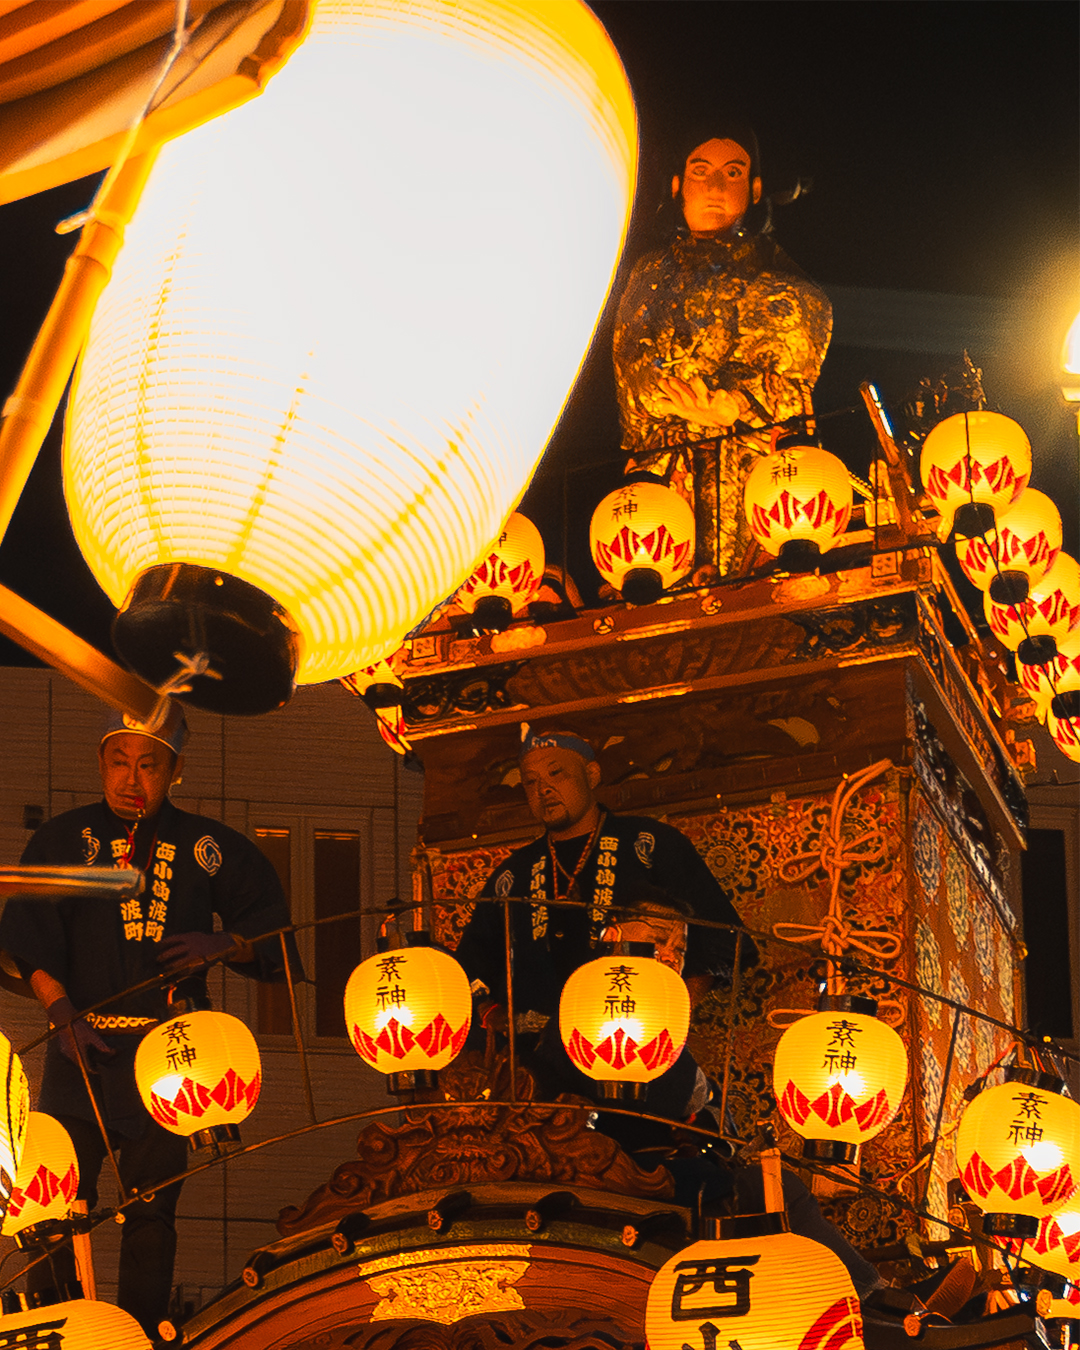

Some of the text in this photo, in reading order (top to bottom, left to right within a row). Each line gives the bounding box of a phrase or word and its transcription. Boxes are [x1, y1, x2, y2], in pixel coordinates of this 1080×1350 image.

[375, 955, 408, 1012] 素神
[602, 964, 639, 1018] 素神
[161, 1018, 197, 1071] 素神
[821, 1019, 863, 1074] 素神
[1006, 1092, 1049, 1147] 素神
